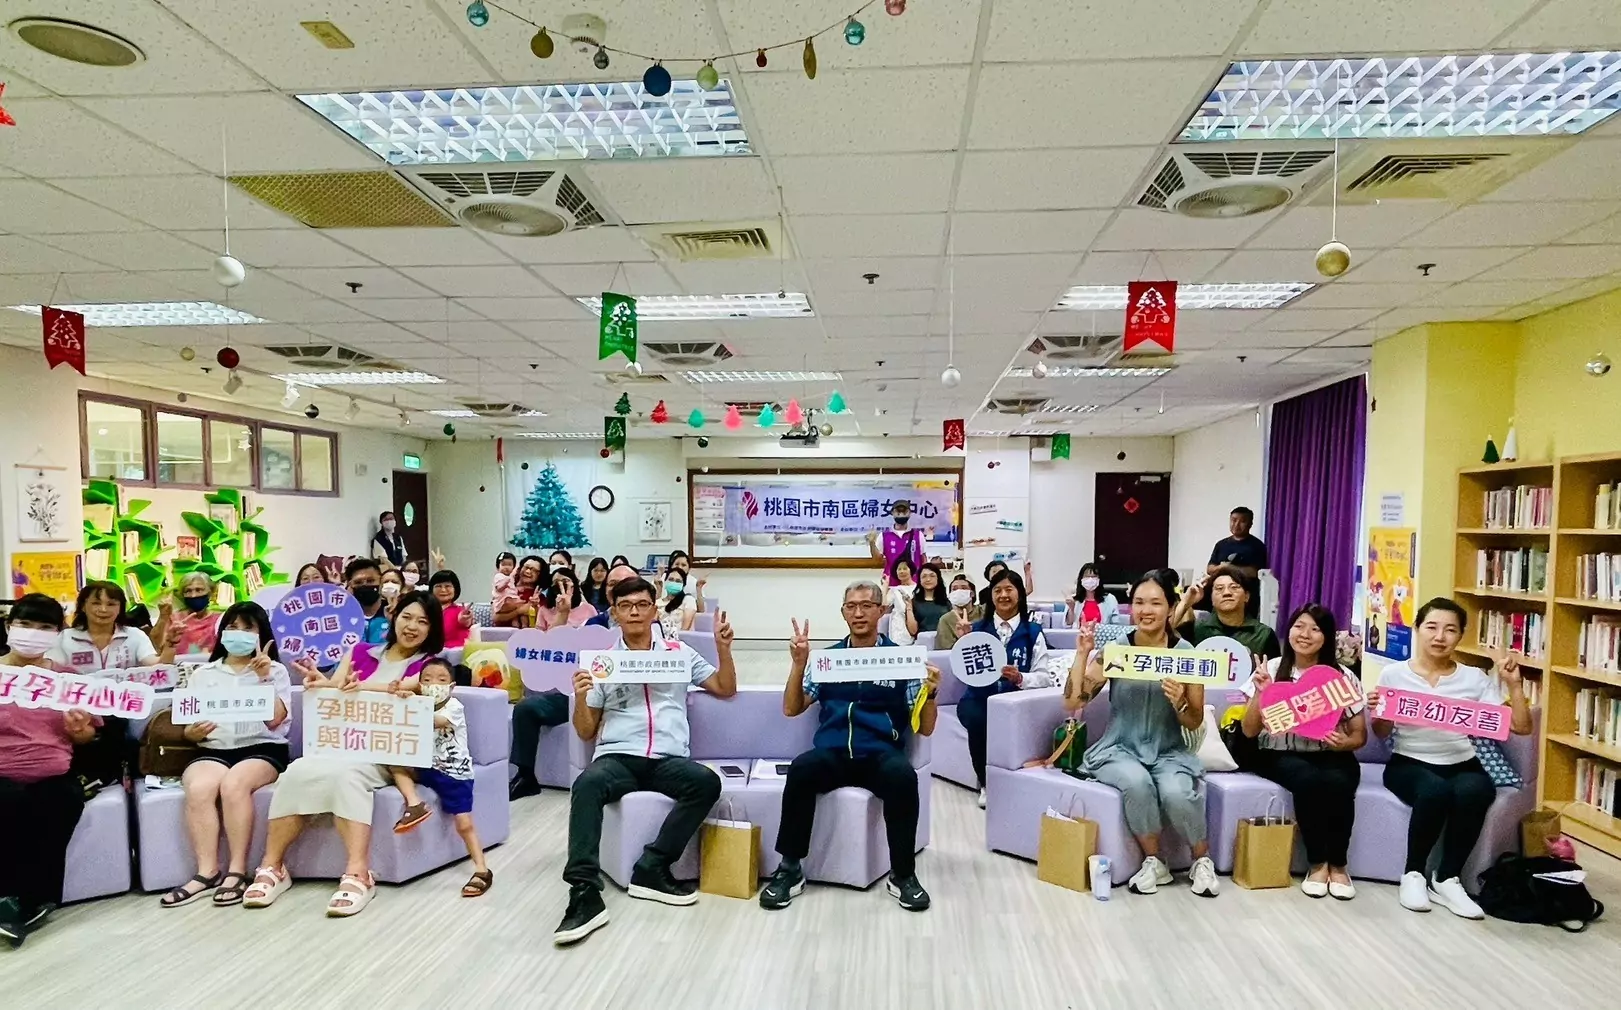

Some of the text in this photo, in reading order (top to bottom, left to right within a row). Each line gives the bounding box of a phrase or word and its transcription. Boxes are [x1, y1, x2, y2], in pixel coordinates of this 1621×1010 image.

[283, 590, 344, 614] 桃園市
[304, 616, 338, 633] 南區
[283, 634, 357, 661] 婦女中心
[515, 646, 580, 664] 婦女權益與
[962, 643, 996, 676] 讚
[1133, 654, 1217, 677] 孕婦運動
[0, 672, 145, 712] 好孕好心情
[206, 698, 266, 709] 桃園市政府
[1261, 675, 1362, 735] 最暖心
[316, 697, 420, 728] 孕期路上
[1397, 697, 1500, 732] 婦幼友善
[316, 725, 420, 755] 與你同行
